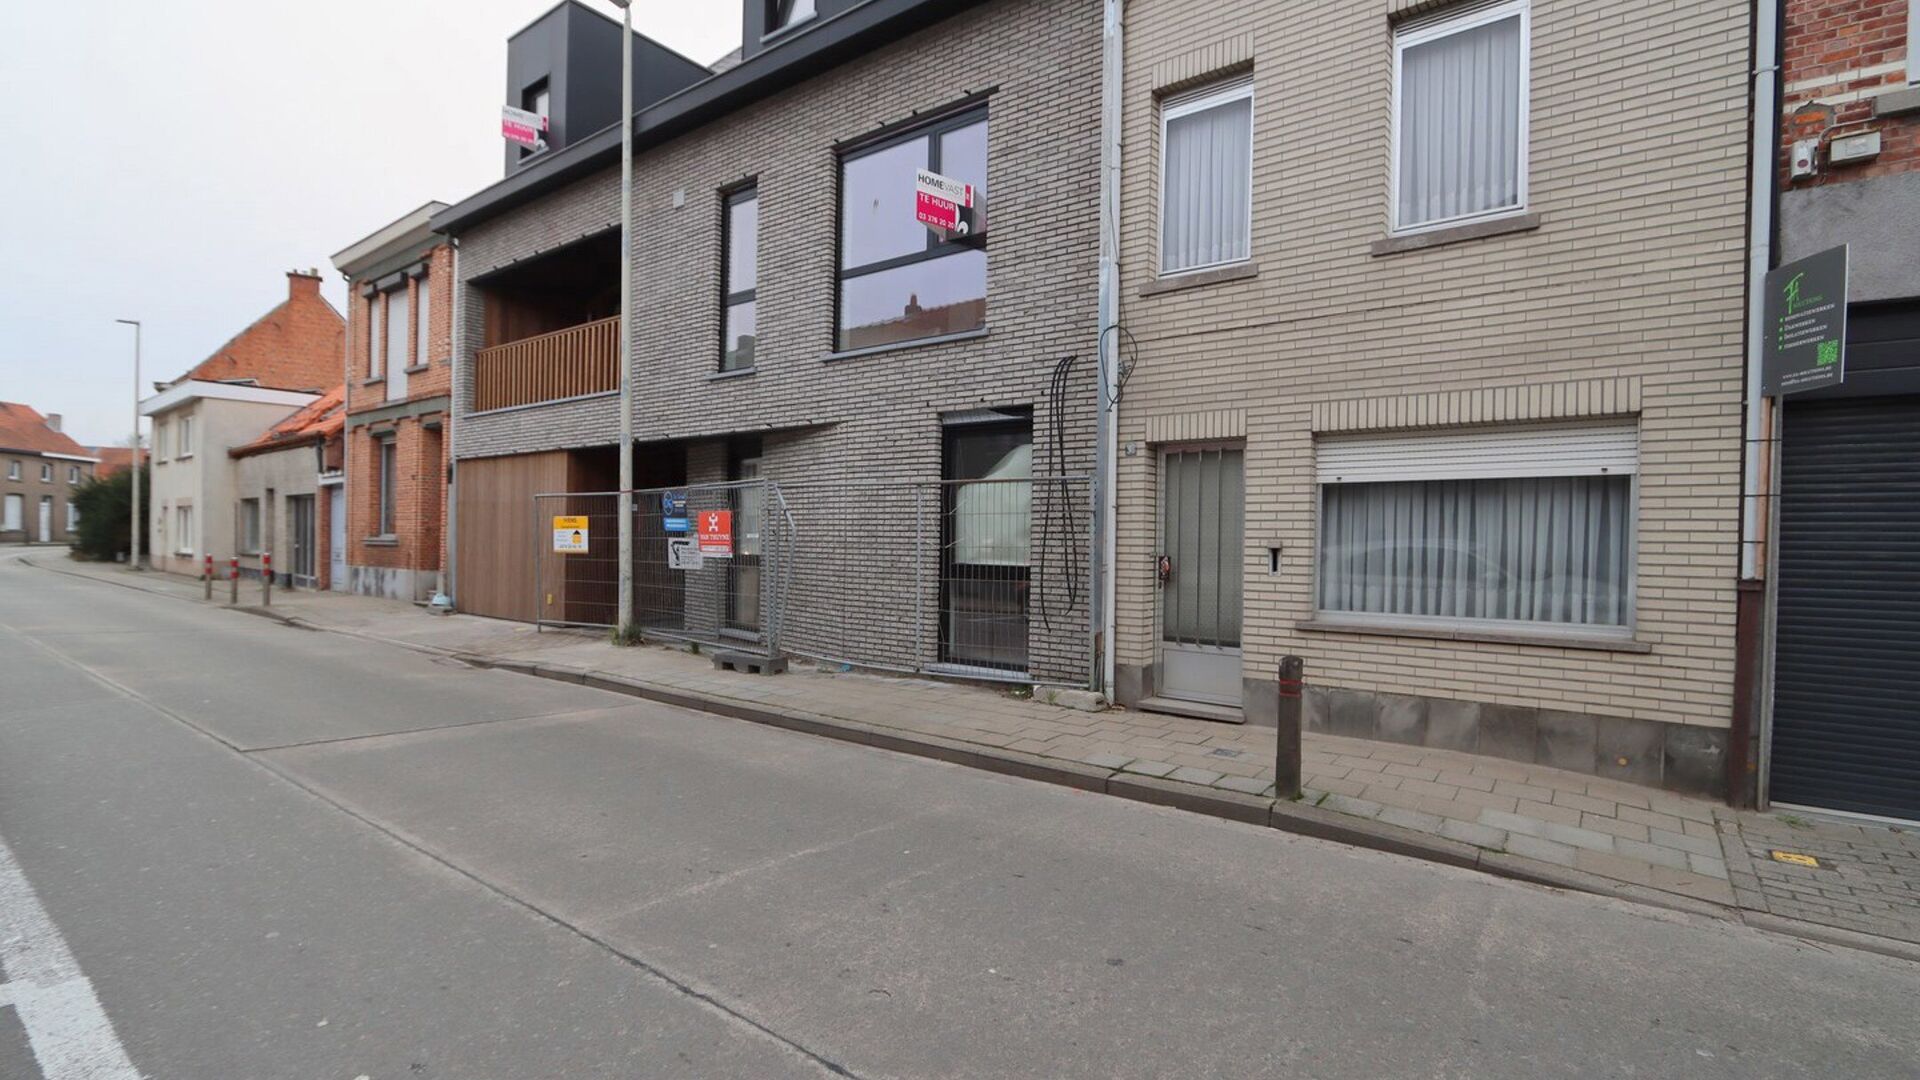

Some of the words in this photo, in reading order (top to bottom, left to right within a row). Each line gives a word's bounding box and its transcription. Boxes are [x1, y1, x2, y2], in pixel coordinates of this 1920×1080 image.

[918, 174, 964, 195] HOMEVAST
[920, 192, 930, 203] TE
[931, 196, 955, 211] HUUR
